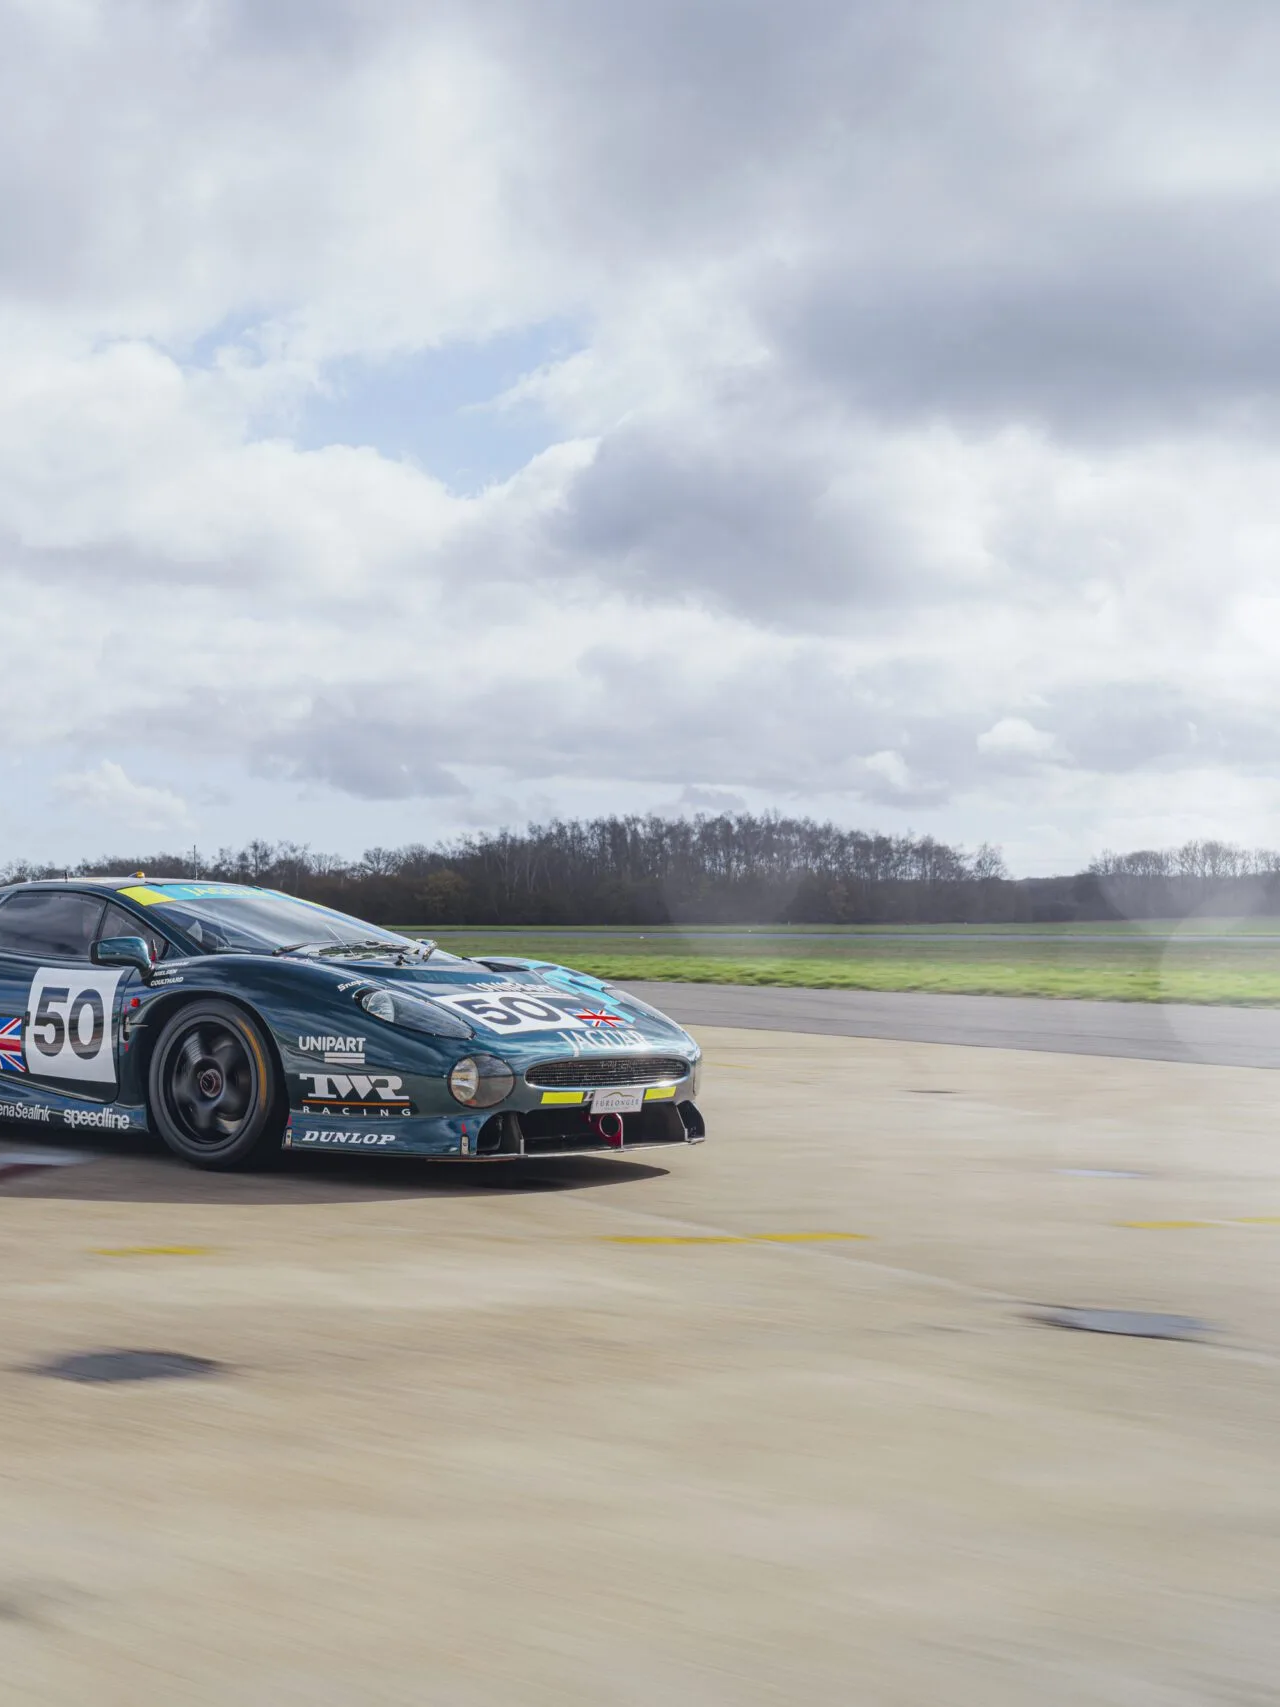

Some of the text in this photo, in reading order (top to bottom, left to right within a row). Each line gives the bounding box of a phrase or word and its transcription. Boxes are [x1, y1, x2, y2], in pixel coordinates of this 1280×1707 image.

[33, 986, 105, 1060] 50
[452, 996, 562, 1026] 50
[298, 1036, 367, 1052] UNIPART
[556, 1029, 653, 1057] JAGUAR
[299, 1073, 410, 1100] TWR
[63, 1107, 130, 1130] speedline
[303, 1105, 412, 1117] RACING
[301, 1130, 397, 1145] DUNLOP
